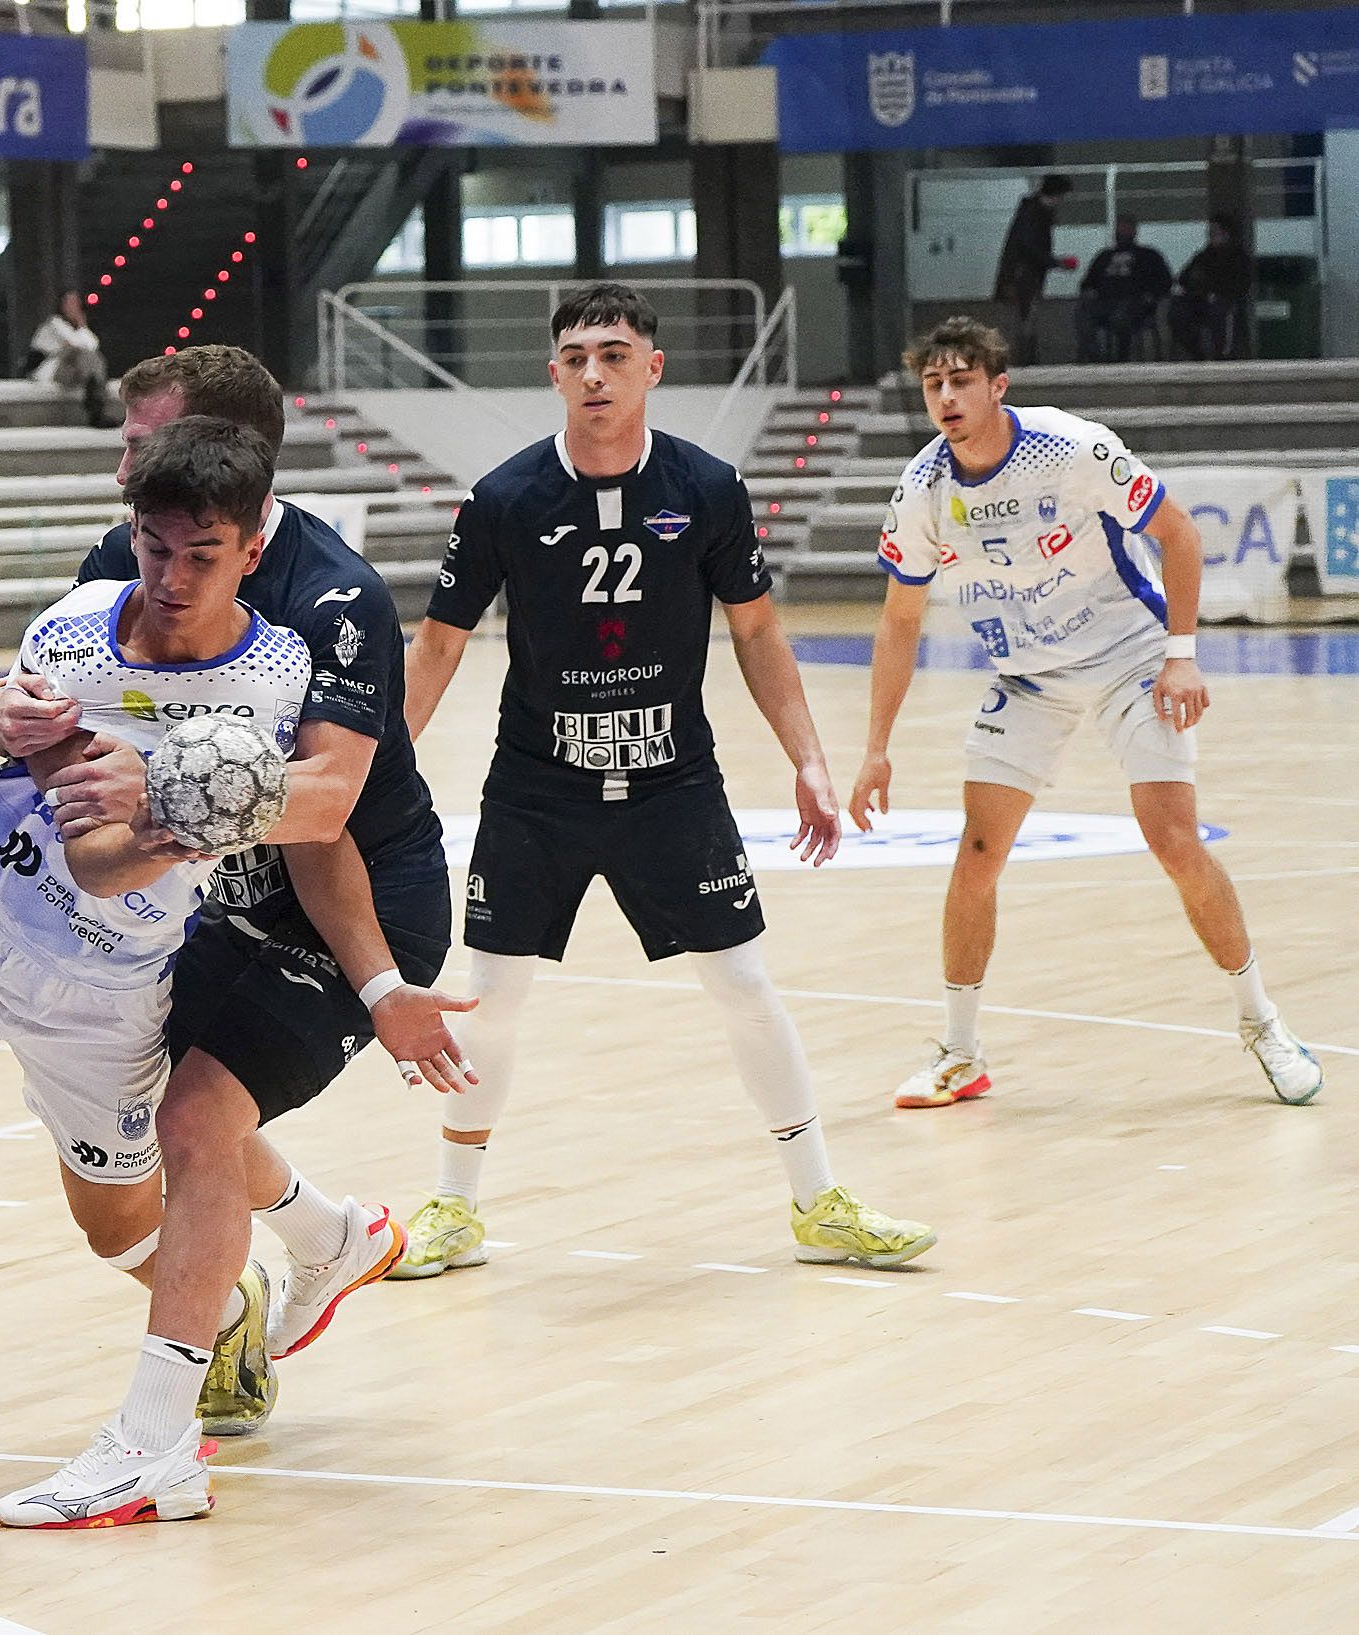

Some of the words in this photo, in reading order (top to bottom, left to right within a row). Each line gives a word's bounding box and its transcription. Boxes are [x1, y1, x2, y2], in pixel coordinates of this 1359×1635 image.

[425, 54, 563, 71] DEPORTE
[425, 78, 629, 96] PONTEVEDRA
[969, 498, 1020, 521] ence
[982, 537, 1012, 566] 5
[581, 543, 643, 604] 22
[48, 646, 94, 663] Kempa
[561, 664, 664, 686] SERVIGROUP
[590, 686, 636, 700] HOTELES
[553, 703, 673, 741] BENI
[553, 732, 676, 770] DORM
[698, 872, 748, 894] suma
